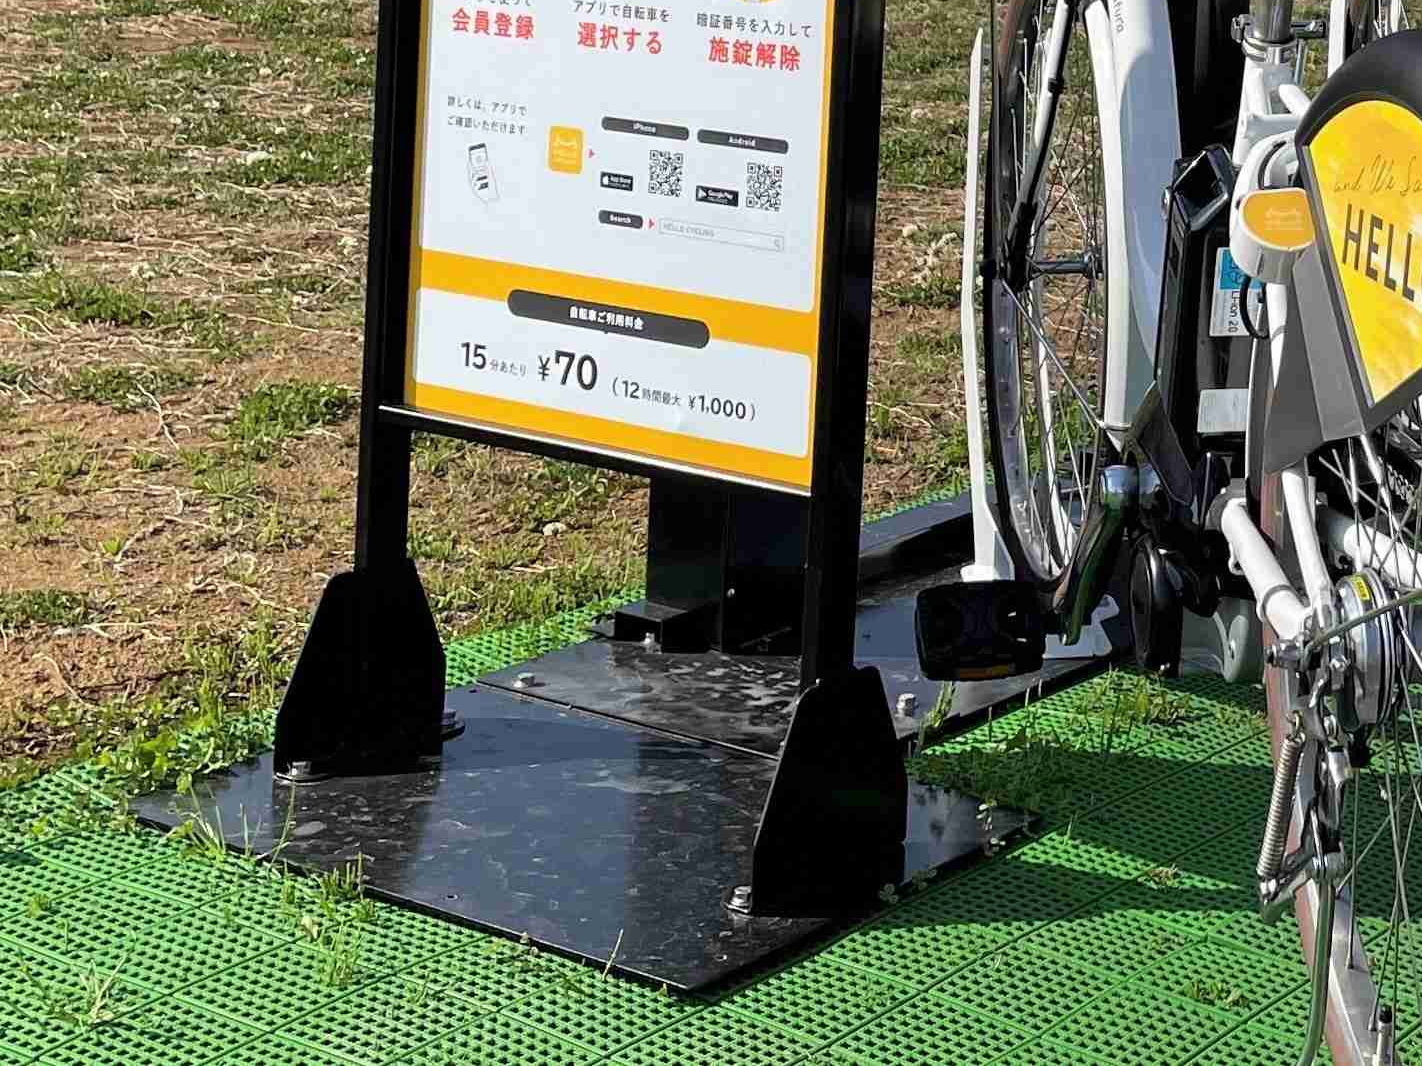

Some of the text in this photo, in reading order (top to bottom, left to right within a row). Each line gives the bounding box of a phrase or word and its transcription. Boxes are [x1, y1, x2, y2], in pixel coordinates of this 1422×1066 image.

[451, 7, 535, 40] 会員登録
[572, 0, 672, 23] アプリで自転車を
[696, 12, 813, 38] 暗証番号を入力して
[576, 21, 663, 55] 選択する
[708, 36, 801, 71] 施錠解除
[537, 349, 599, 391] ¥70
